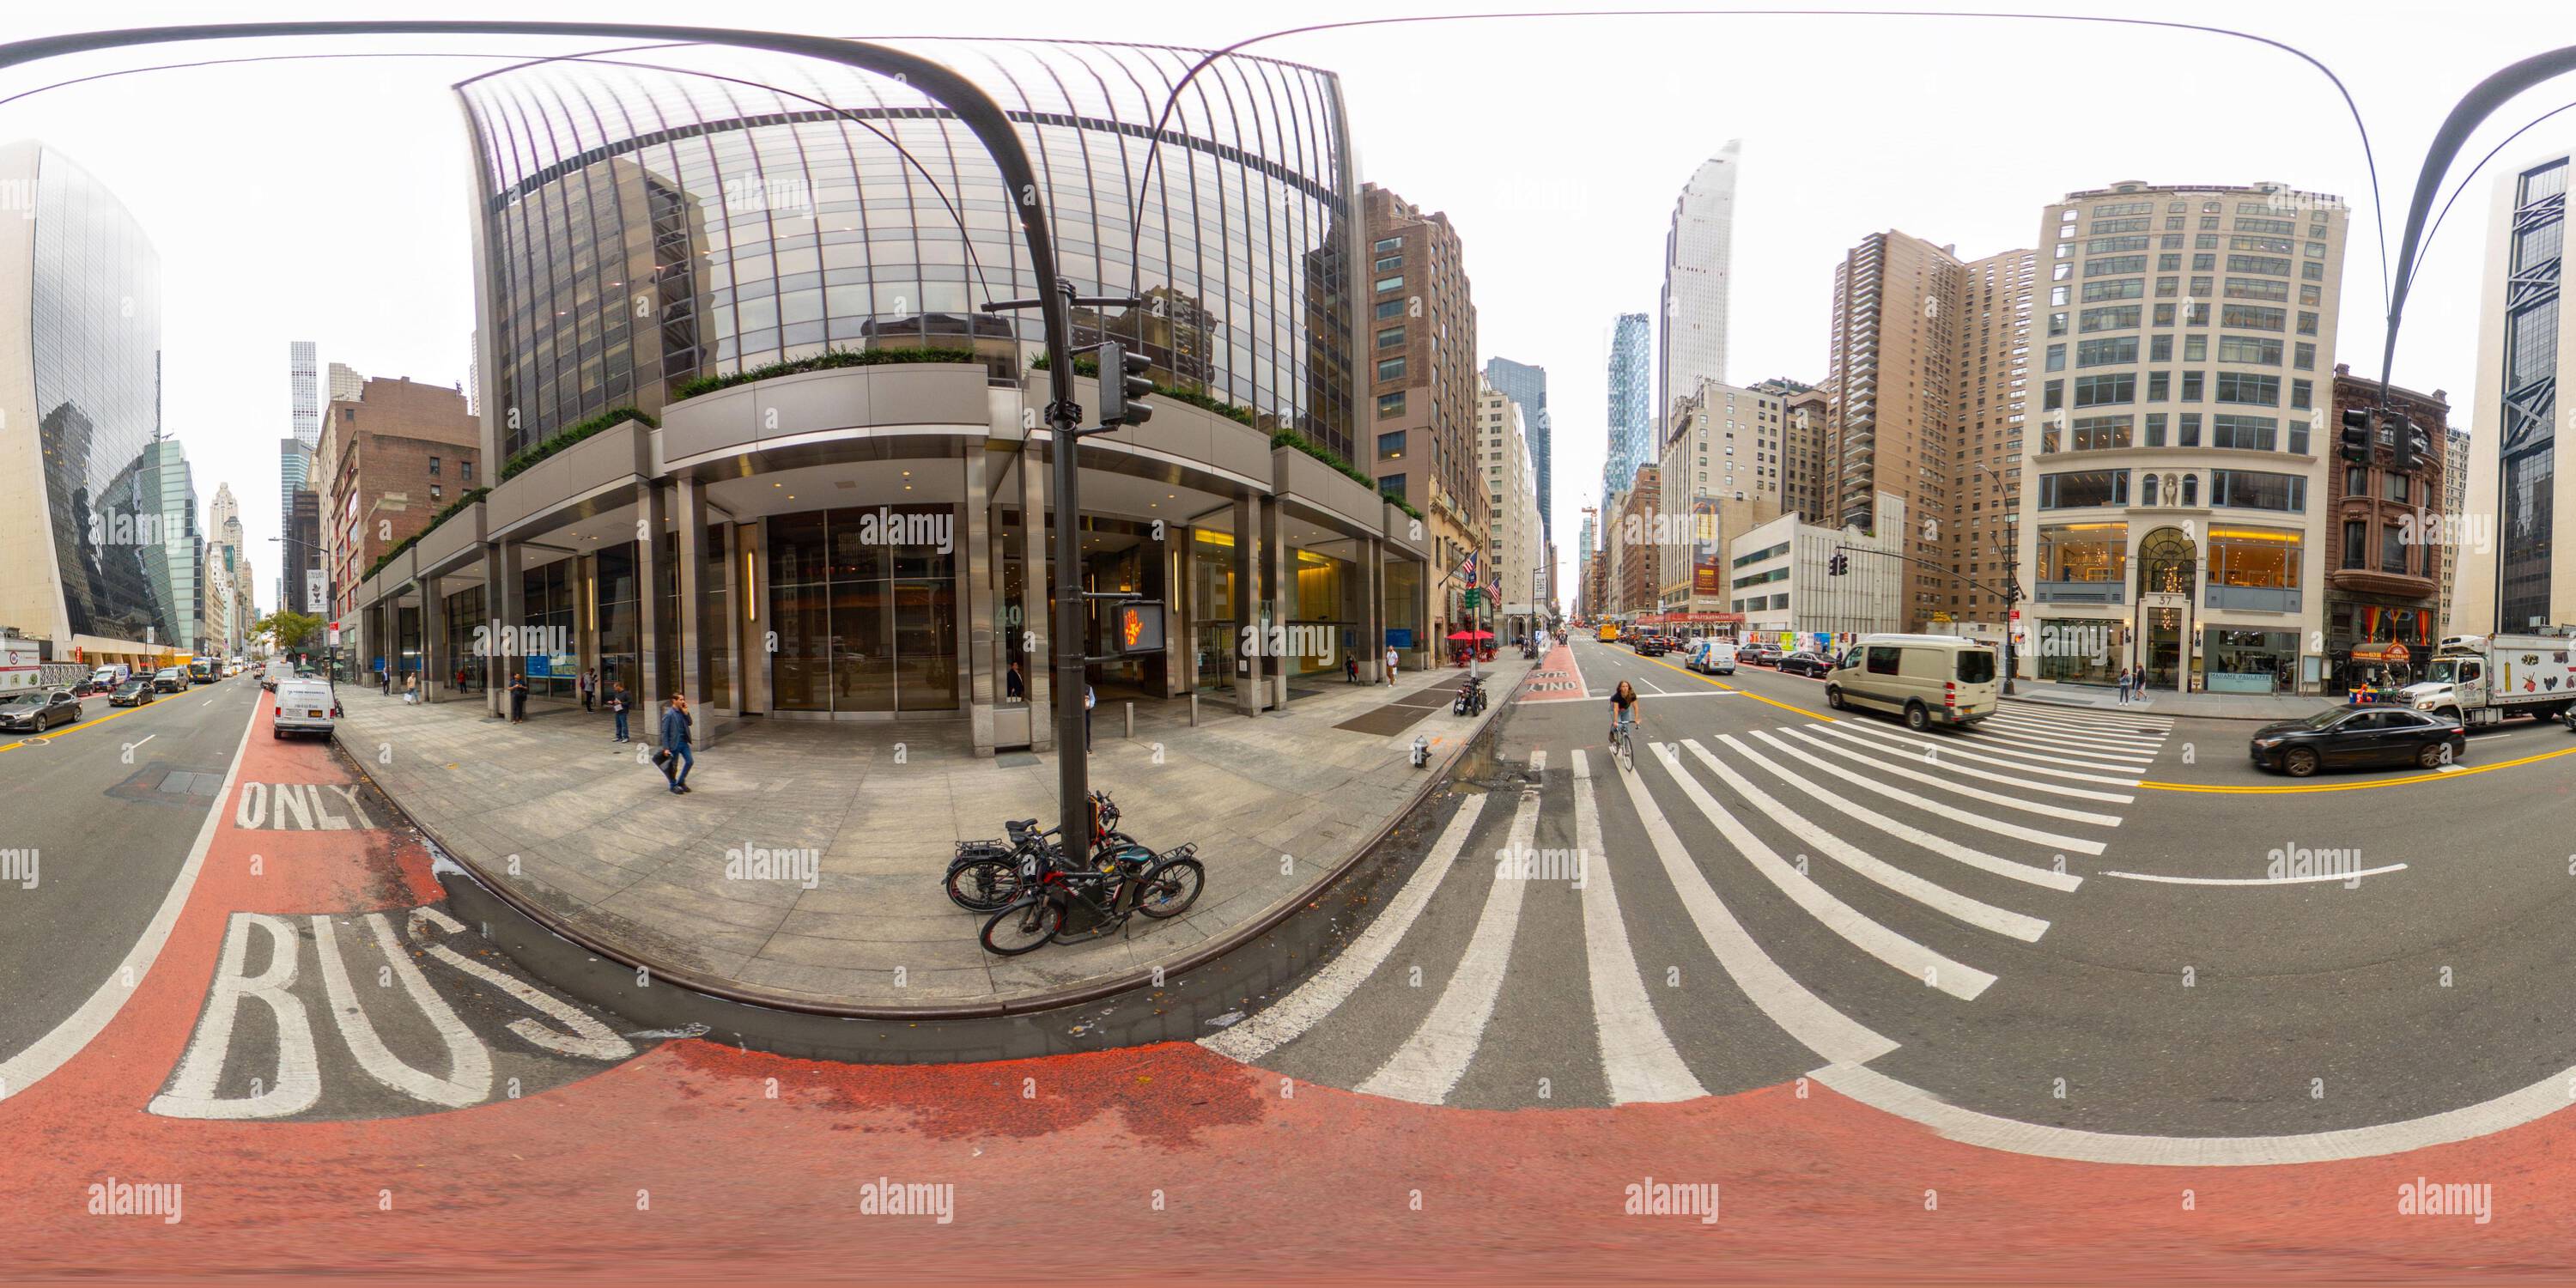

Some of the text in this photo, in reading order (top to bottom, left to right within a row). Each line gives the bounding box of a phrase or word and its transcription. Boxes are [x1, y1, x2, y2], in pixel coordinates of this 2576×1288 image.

[2159, 596, 2172, 605] 37
[996, 605, 1022, 625] 40
[1528, 682, 1577, 692] ONLY
[237, 781, 375, 830] ONLY
[148, 906, 636, 1119] BUS
